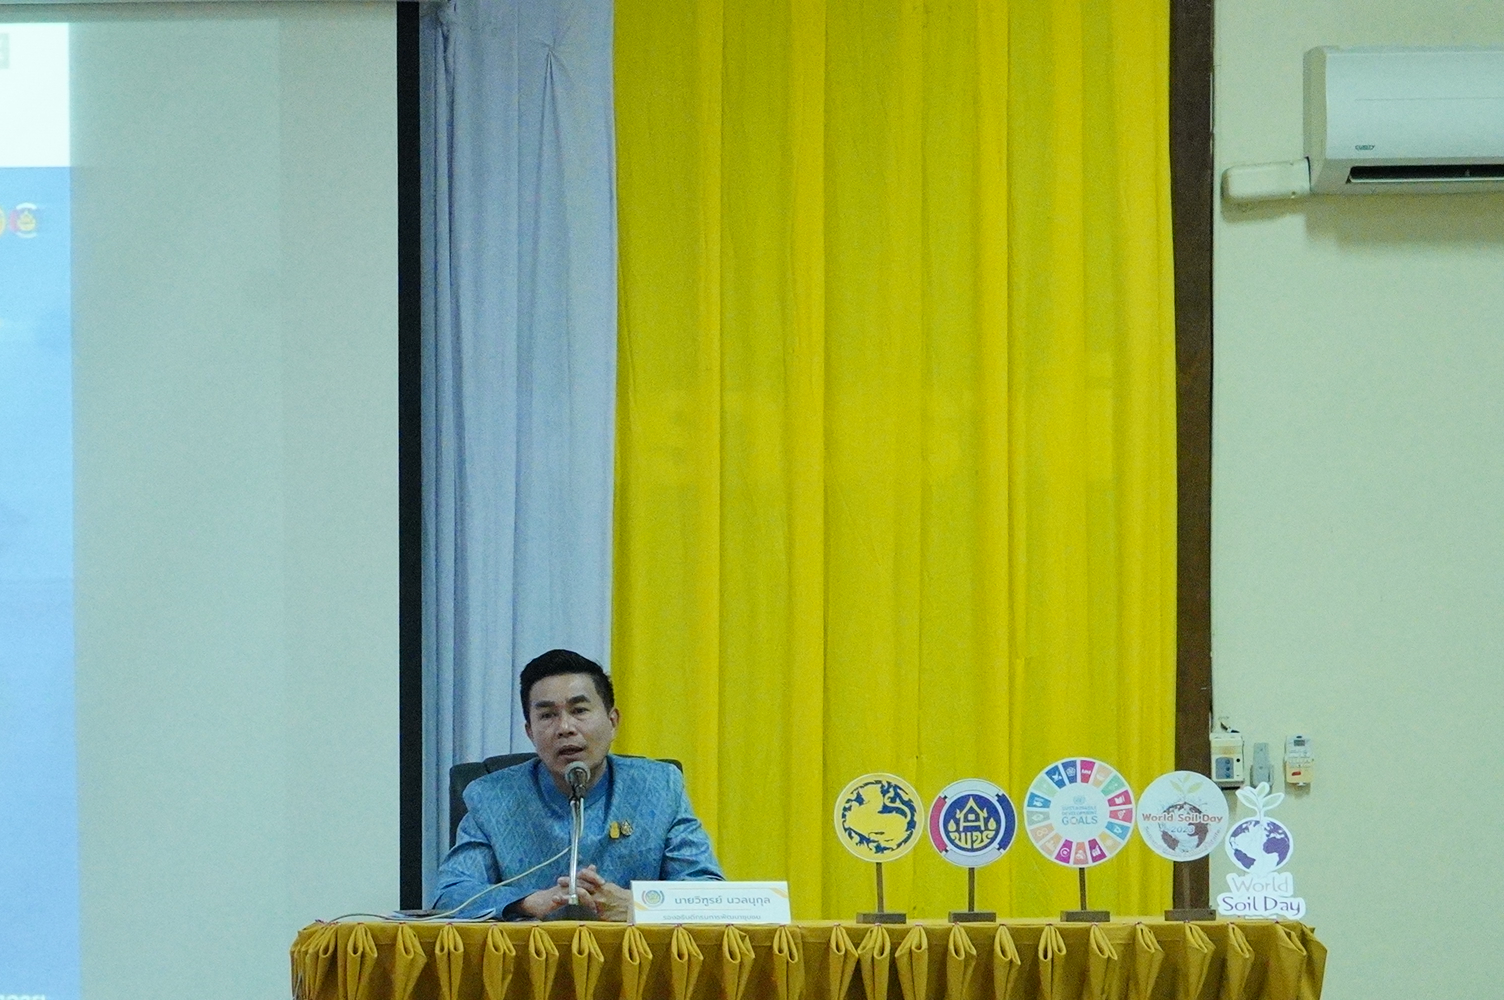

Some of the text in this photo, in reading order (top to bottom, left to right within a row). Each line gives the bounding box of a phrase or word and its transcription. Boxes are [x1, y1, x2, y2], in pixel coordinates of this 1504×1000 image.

[1061, 815, 1098, 826] GOALS
[1141, 813, 1224, 824] World Soil Day
[1232, 876, 1290, 894] World
[1222, 896, 1302, 915] Soil Day
